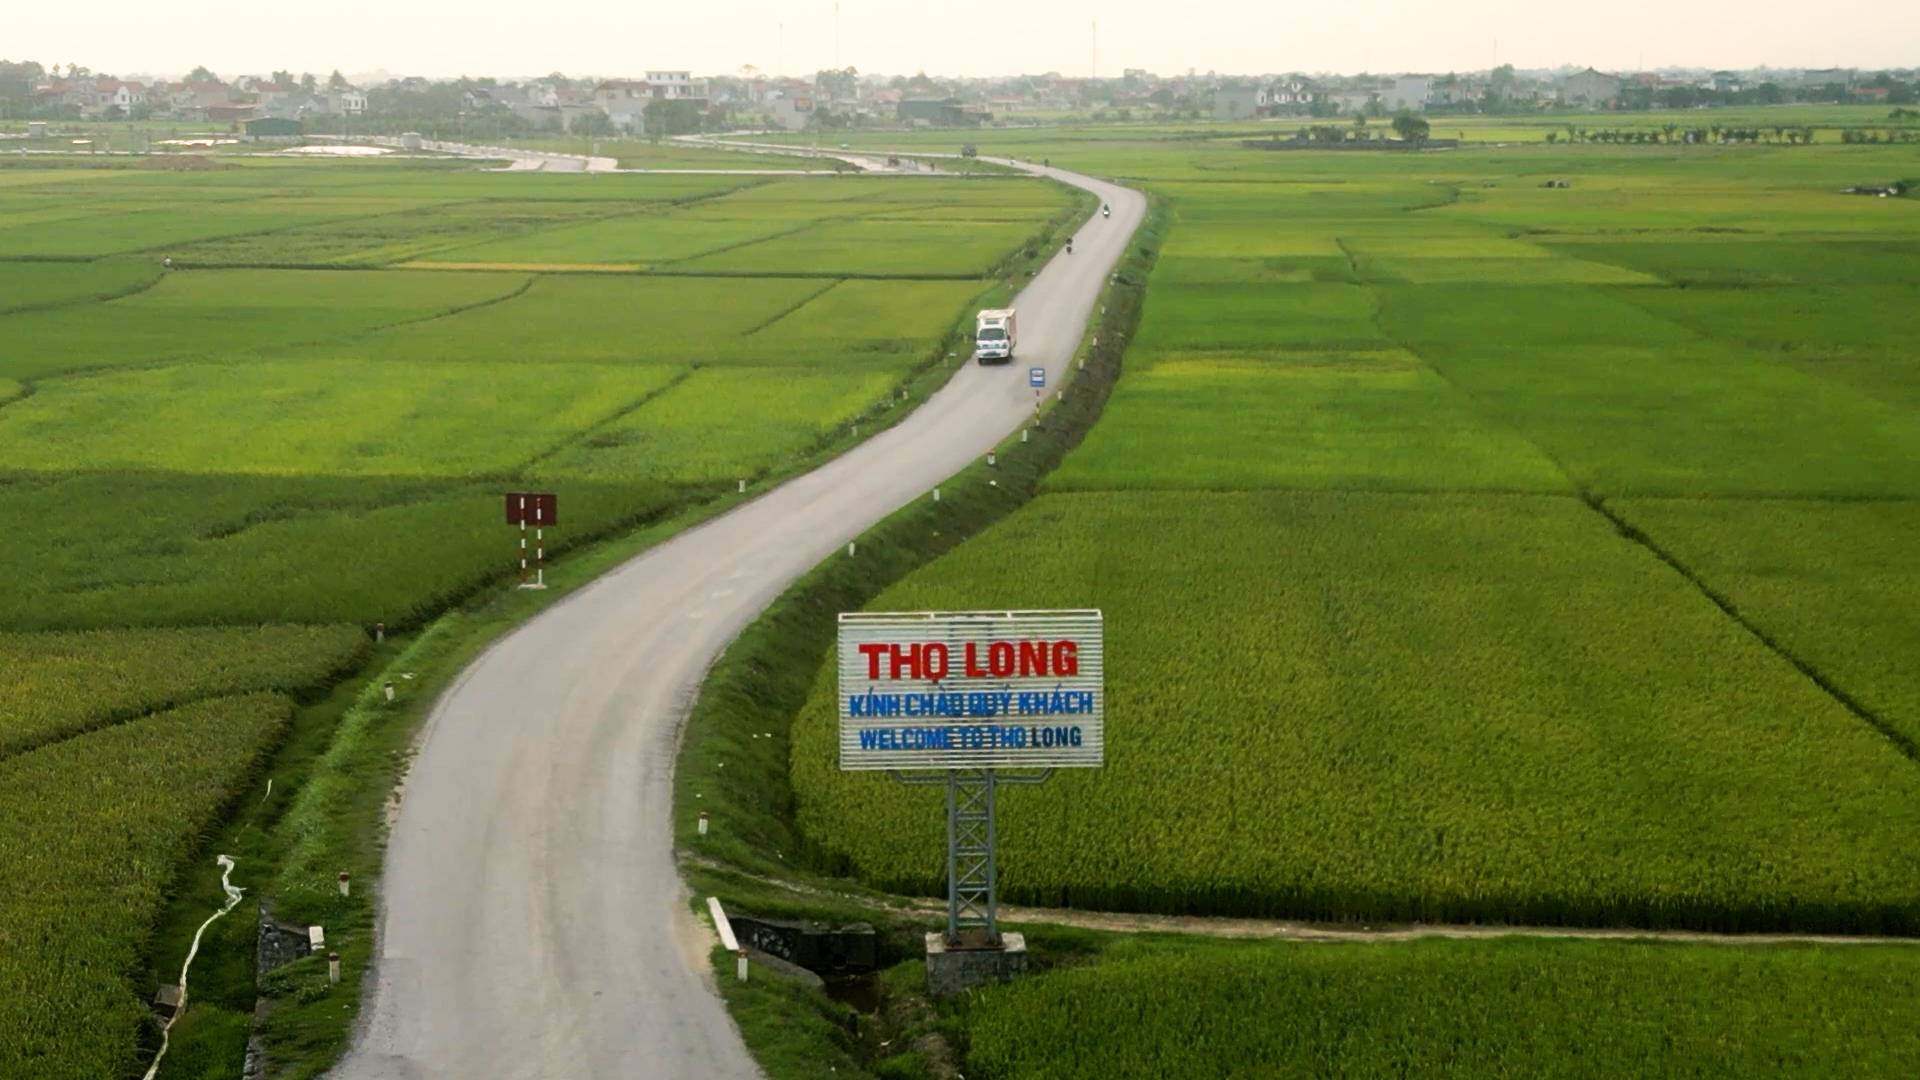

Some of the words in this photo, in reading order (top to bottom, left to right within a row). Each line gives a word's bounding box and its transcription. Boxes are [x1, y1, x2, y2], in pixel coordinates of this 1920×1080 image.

[858, 643, 948, 684] THỌ
[965, 640, 1079, 677] LONG
[849, 686, 900, 717] KÍNH
[905, 685, 963, 716] CHÀO
[968, 684, 1012, 716] QUÝ
[1017, 683, 1093, 715] KHÁCH
[859, 727, 953, 750] WELCOME
[958, 727, 983, 749] TO
[988, 726, 1026, 749] THO
[1031, 725, 1082, 747] LONG
